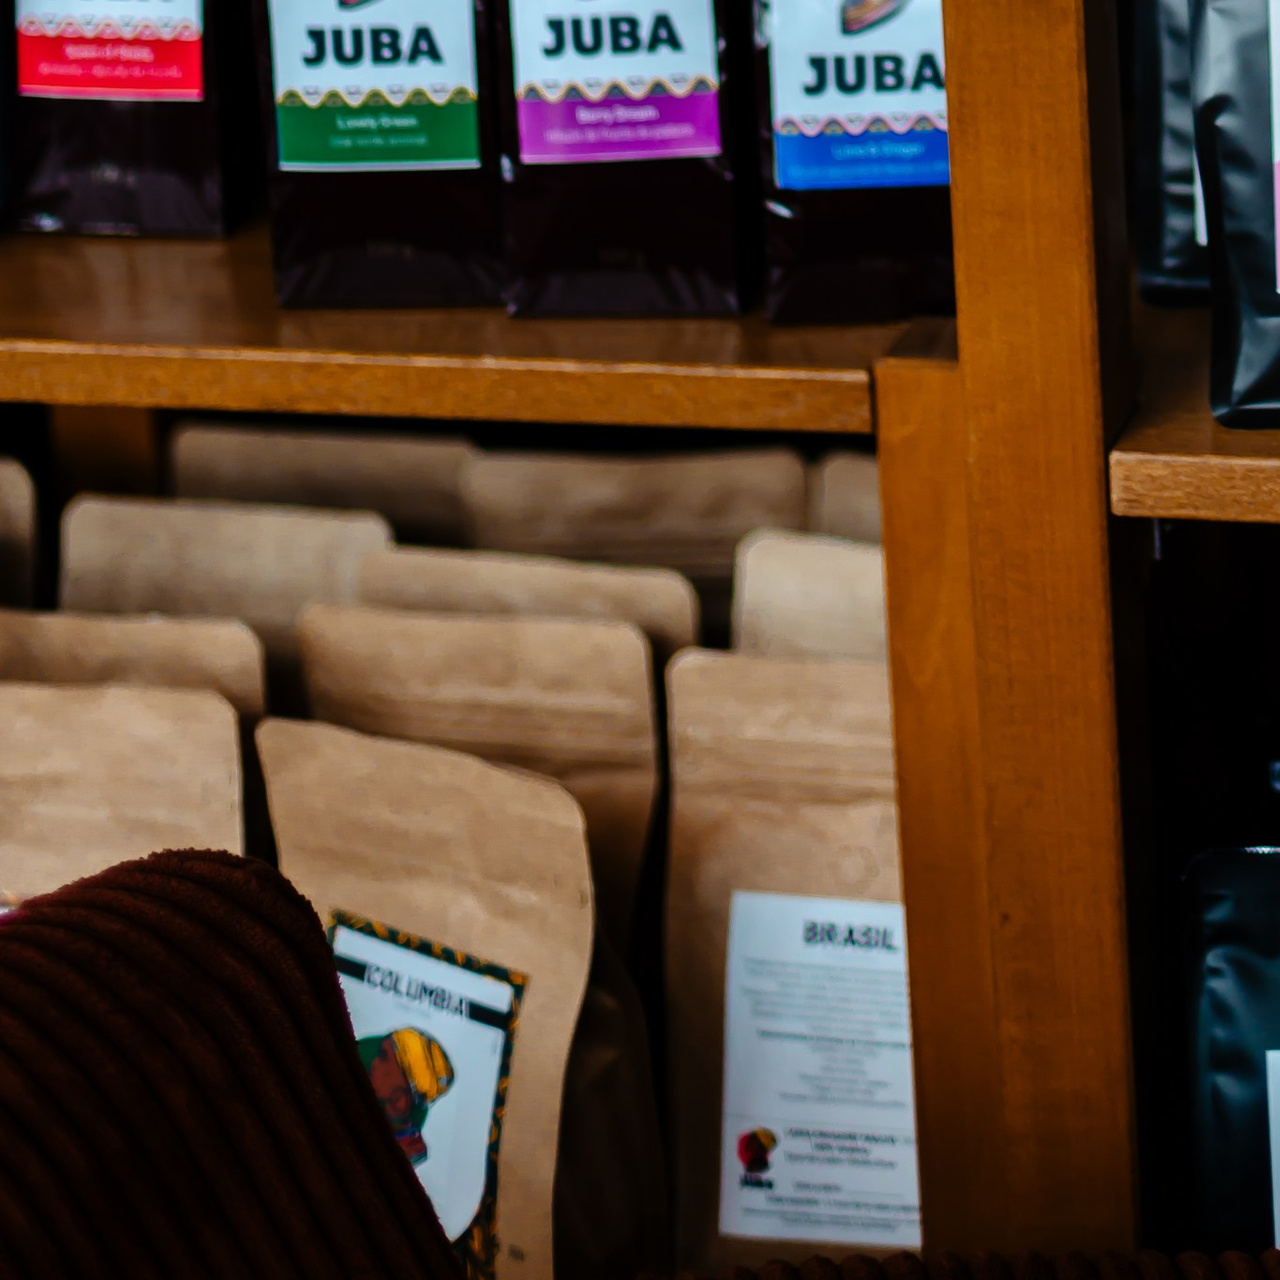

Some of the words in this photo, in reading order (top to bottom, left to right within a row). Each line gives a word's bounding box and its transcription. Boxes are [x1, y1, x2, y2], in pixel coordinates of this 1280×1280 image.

[301, 25, 444, 68] JUBA
[541, 14, 683, 58] JUBA
[802, 50, 947, 97] JUBA
[802, 920, 898, 952] BRASIL
[365, 963, 465, 1021] COLUMBIA
